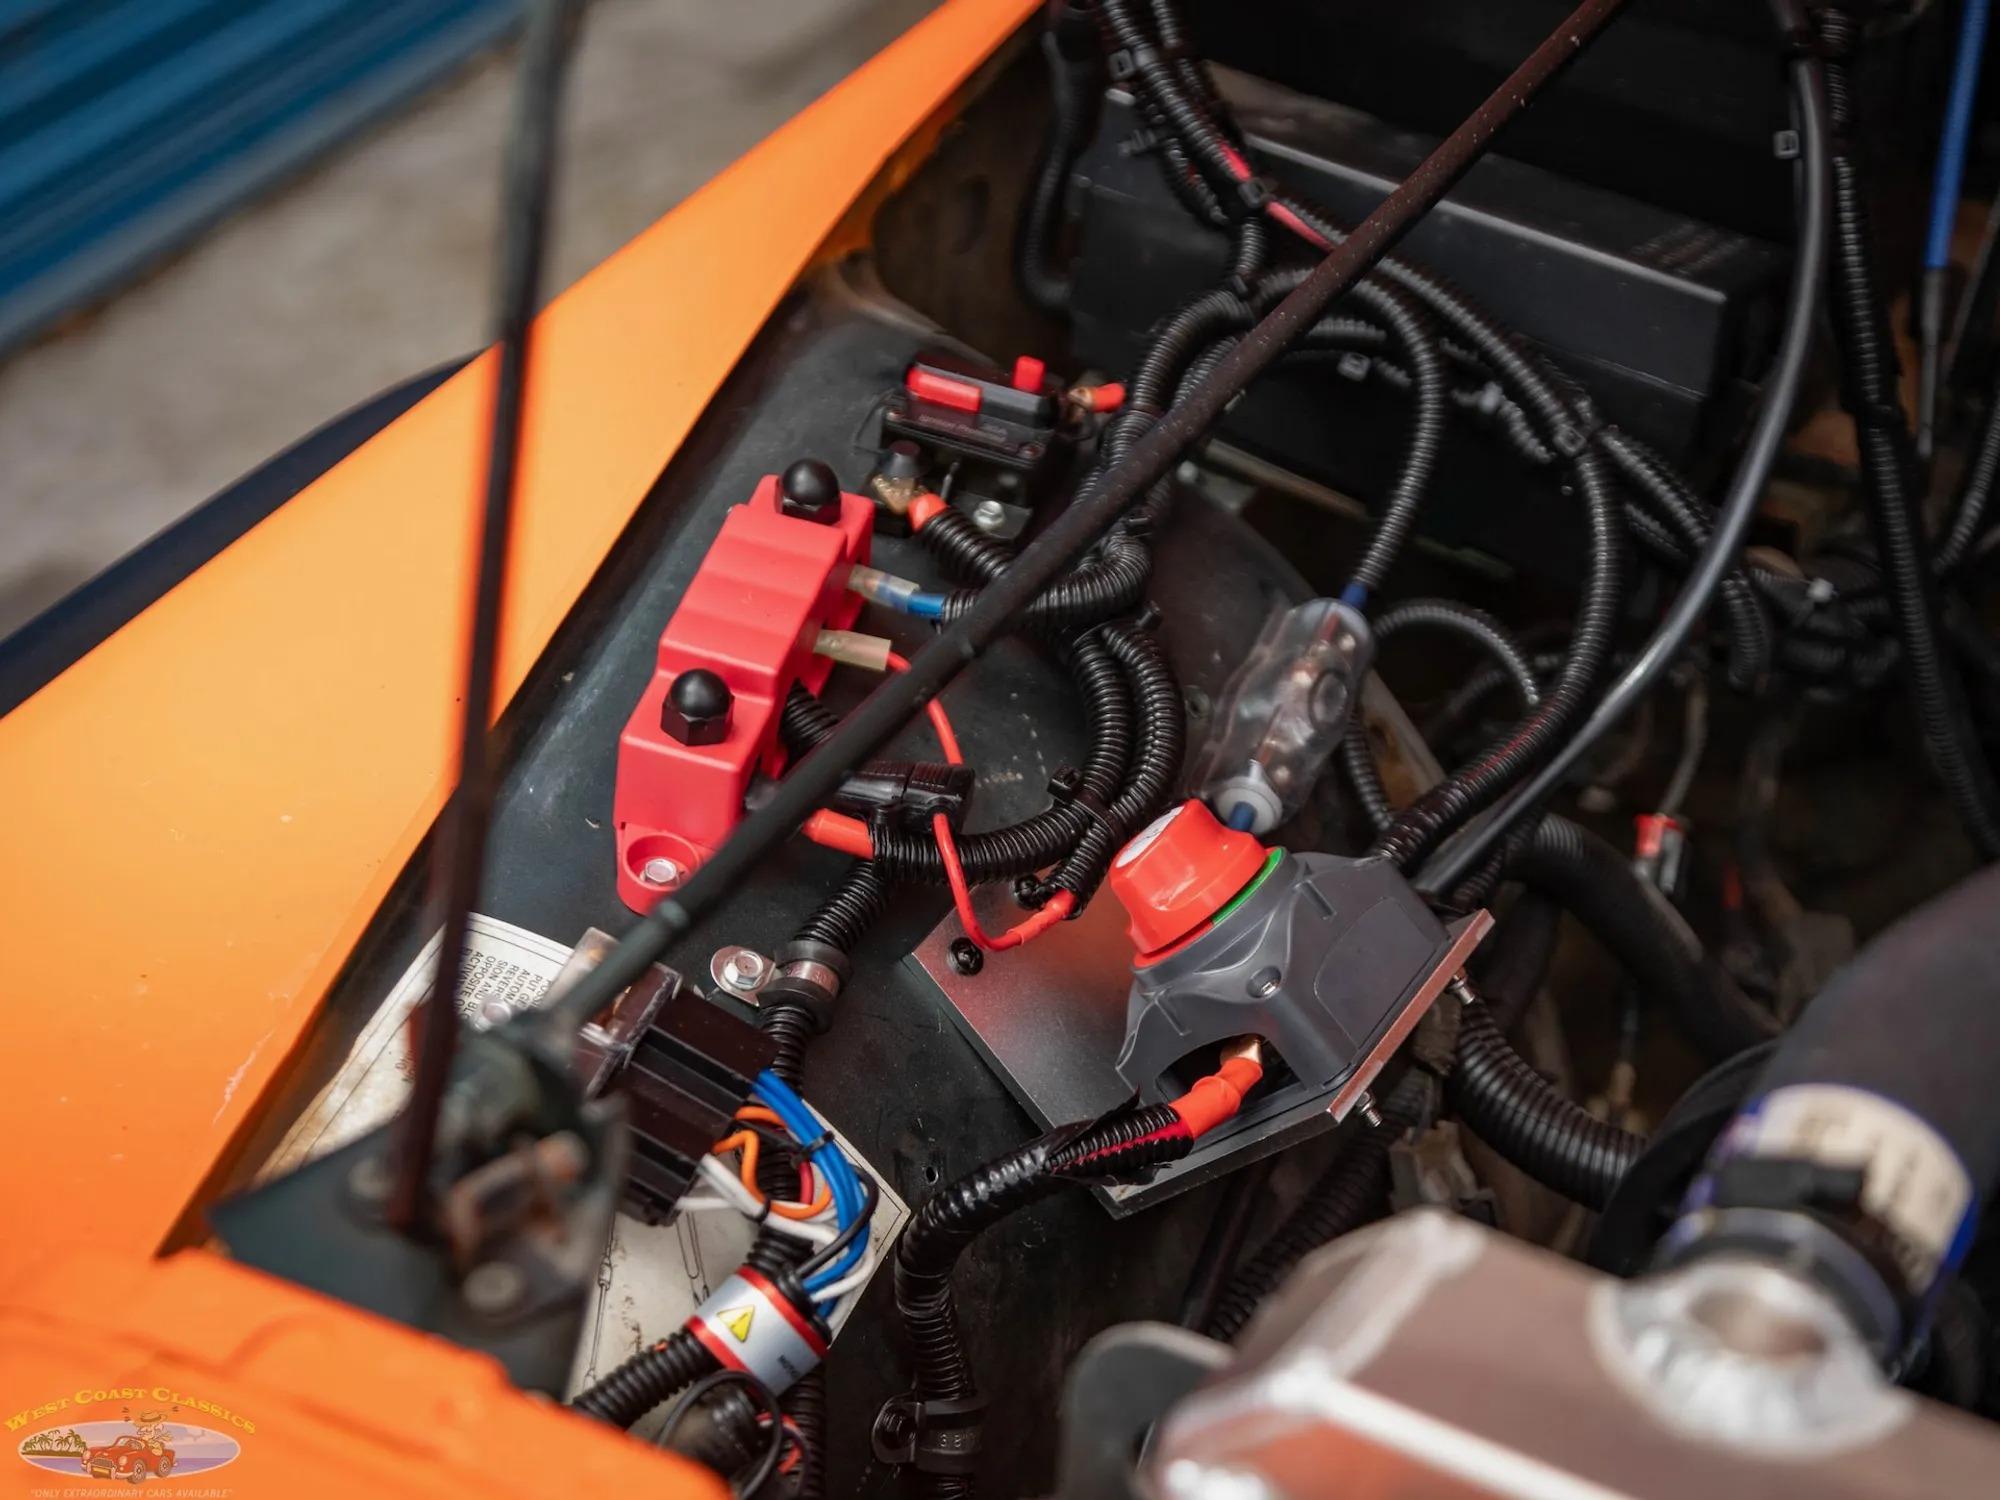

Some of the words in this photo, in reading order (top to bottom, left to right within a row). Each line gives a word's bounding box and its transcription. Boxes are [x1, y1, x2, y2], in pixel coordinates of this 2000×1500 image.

[460, 954, 496, 998] OPPOSITE
[487, 959, 507, 981] SION
[473, 981, 492, 1000] AND
[527, 974, 543, 992] PUT
